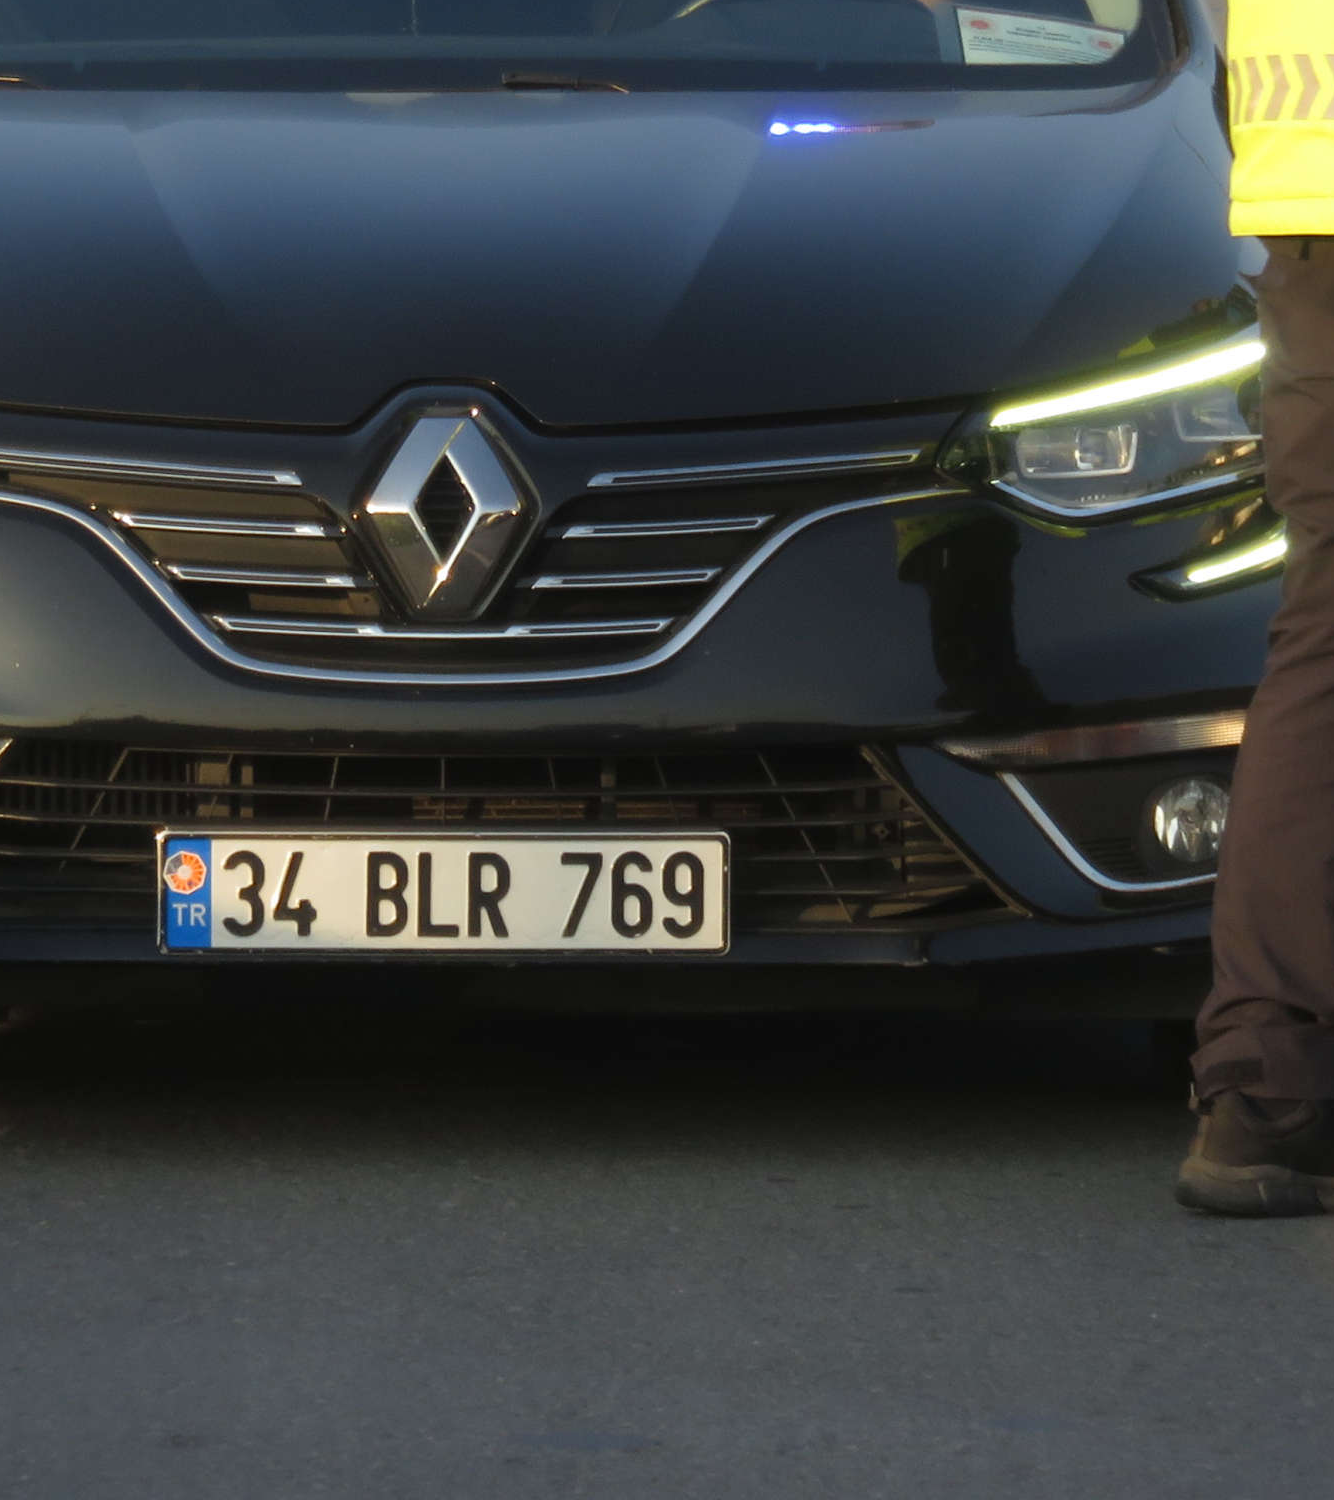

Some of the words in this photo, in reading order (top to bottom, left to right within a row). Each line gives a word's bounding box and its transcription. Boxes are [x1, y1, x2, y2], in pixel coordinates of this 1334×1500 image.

[172, 903, 207, 927] TR
[221, 850, 318, 938] 34
[366, 850, 511, 938] BLR
[560, 850, 705, 939] 769
